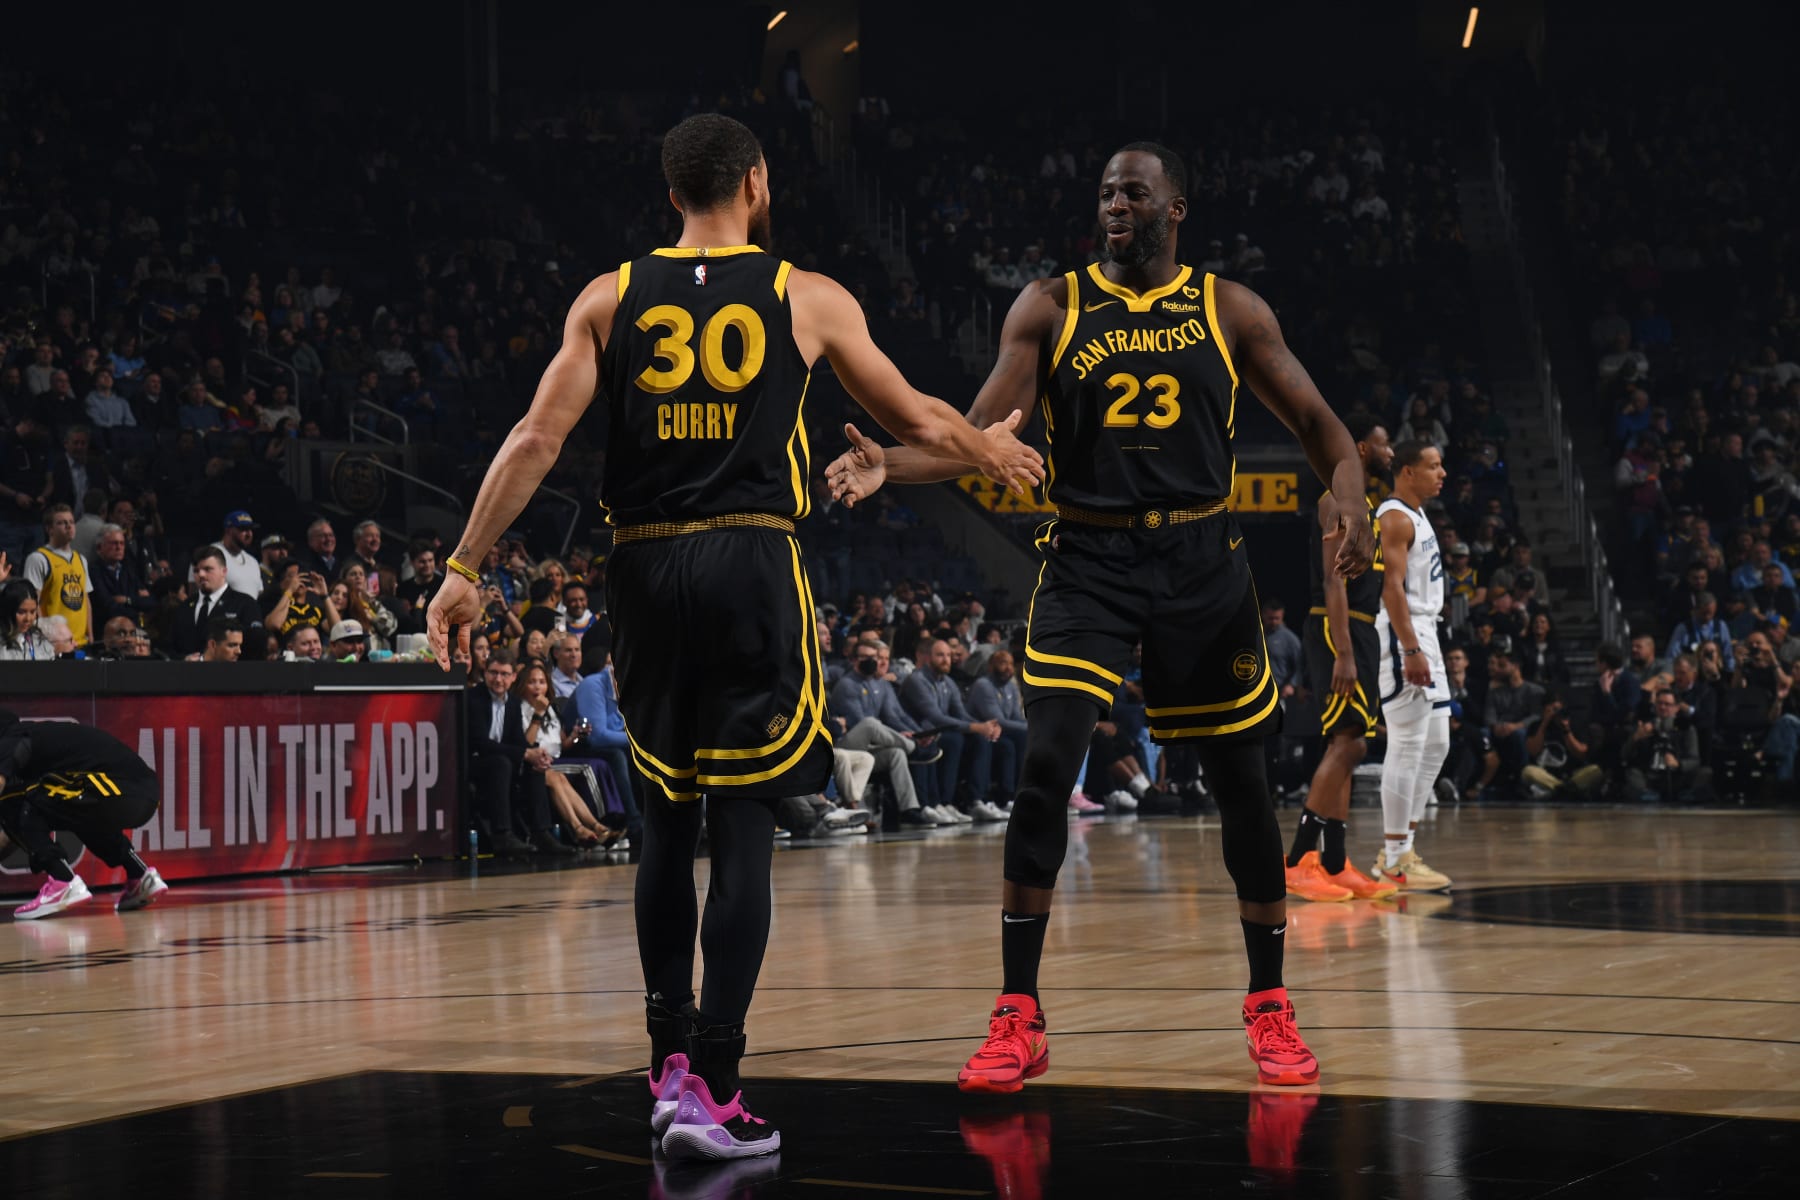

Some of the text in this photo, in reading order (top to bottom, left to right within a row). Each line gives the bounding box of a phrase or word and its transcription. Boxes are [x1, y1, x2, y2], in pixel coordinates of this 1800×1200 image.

[1162, 300, 1200, 312] Rakuten
[634, 303, 766, 394] 30
[1071, 318, 1206, 380] SAN FRANCISCO
[657, 402, 738, 440] CURRY
[1103, 372, 1182, 429] 23
[132, 720, 444, 851] ALL IN THE APP.
